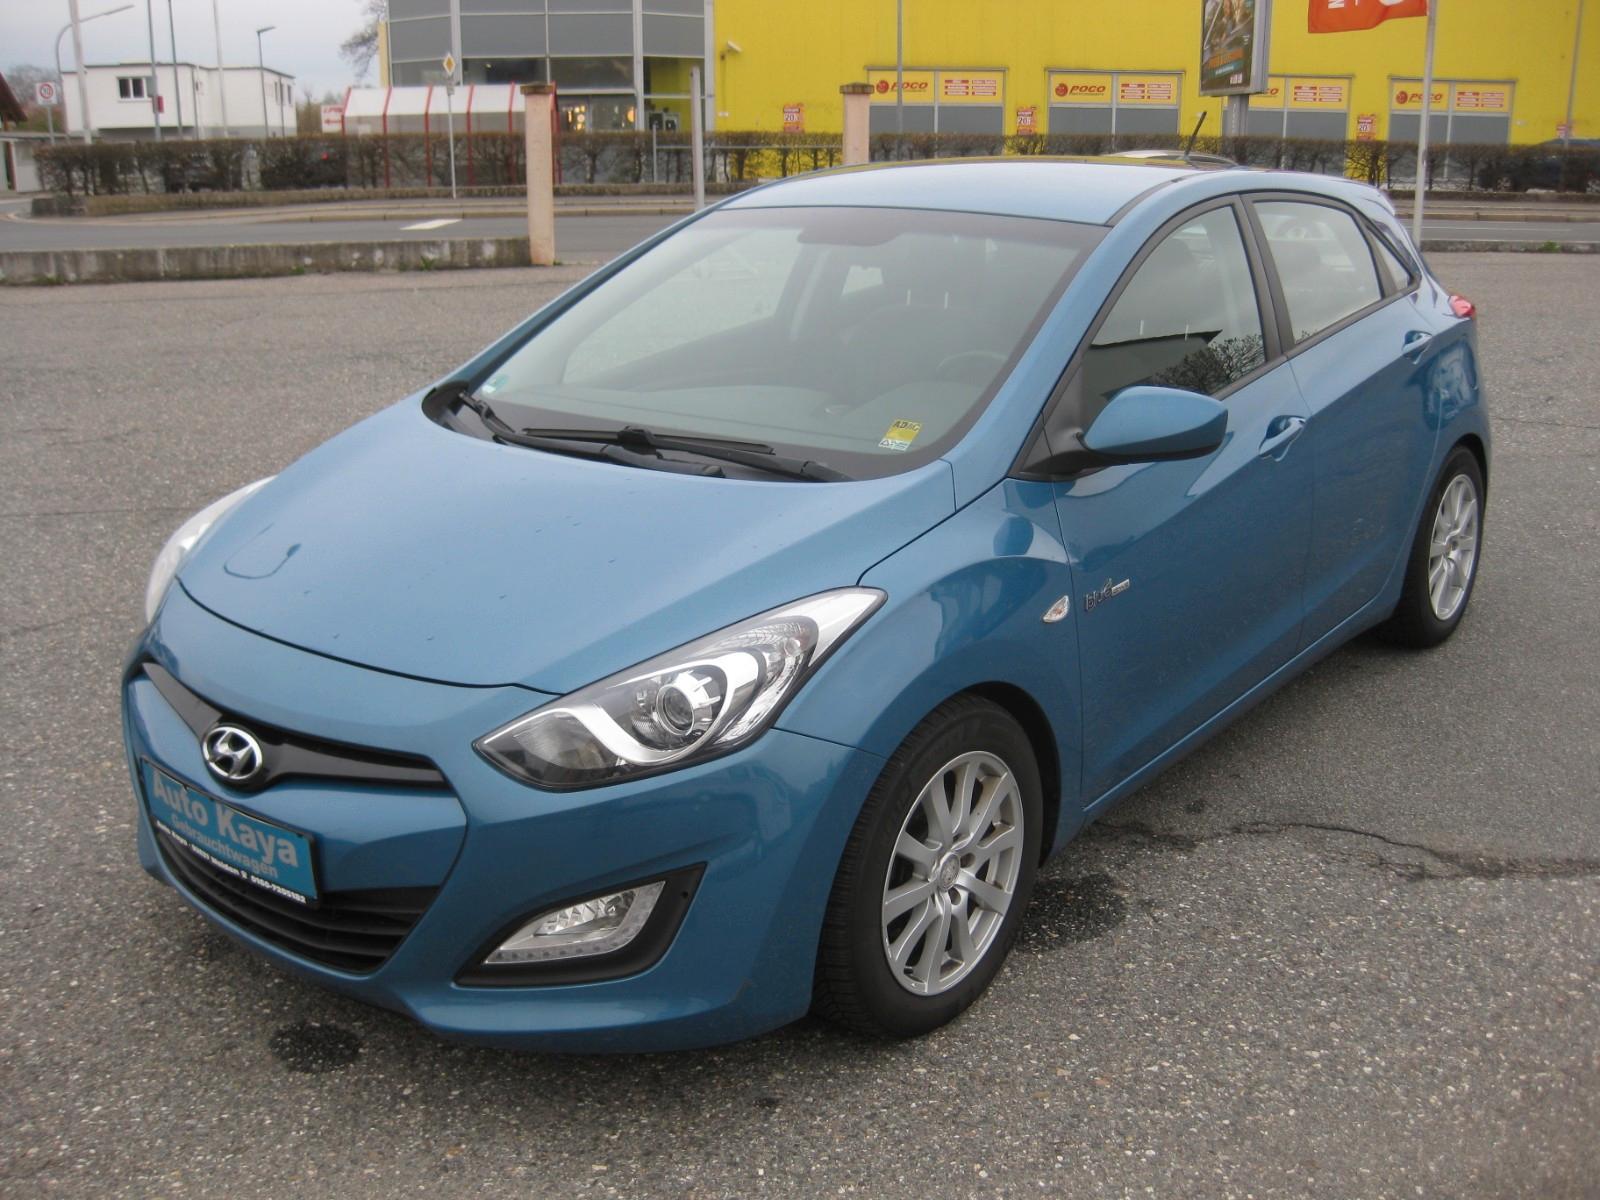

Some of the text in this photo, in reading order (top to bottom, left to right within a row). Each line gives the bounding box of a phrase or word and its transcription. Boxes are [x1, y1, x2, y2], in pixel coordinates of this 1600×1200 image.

[1070, 84, 1106, 94] POCO
[153, 765, 299, 868] Auto Kaya
[171, 813, 279, 879] Gebrauchtwagen
